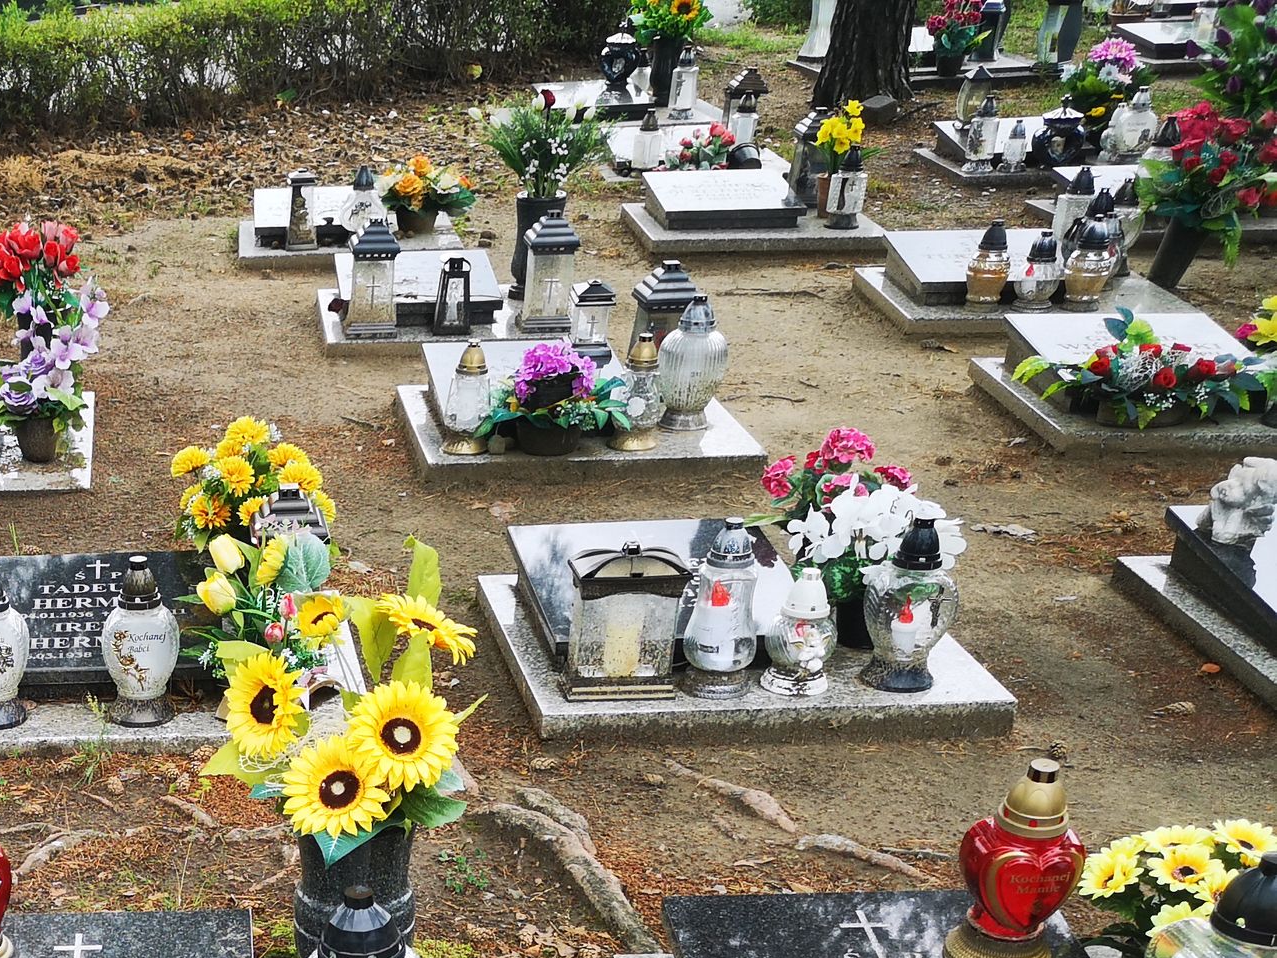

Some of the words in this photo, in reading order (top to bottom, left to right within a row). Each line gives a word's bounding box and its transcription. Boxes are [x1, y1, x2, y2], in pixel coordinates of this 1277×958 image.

[111, 571, 123, 579] P
[38, 582, 123, 595] TADEU
[32, 596, 120, 610] HERM
